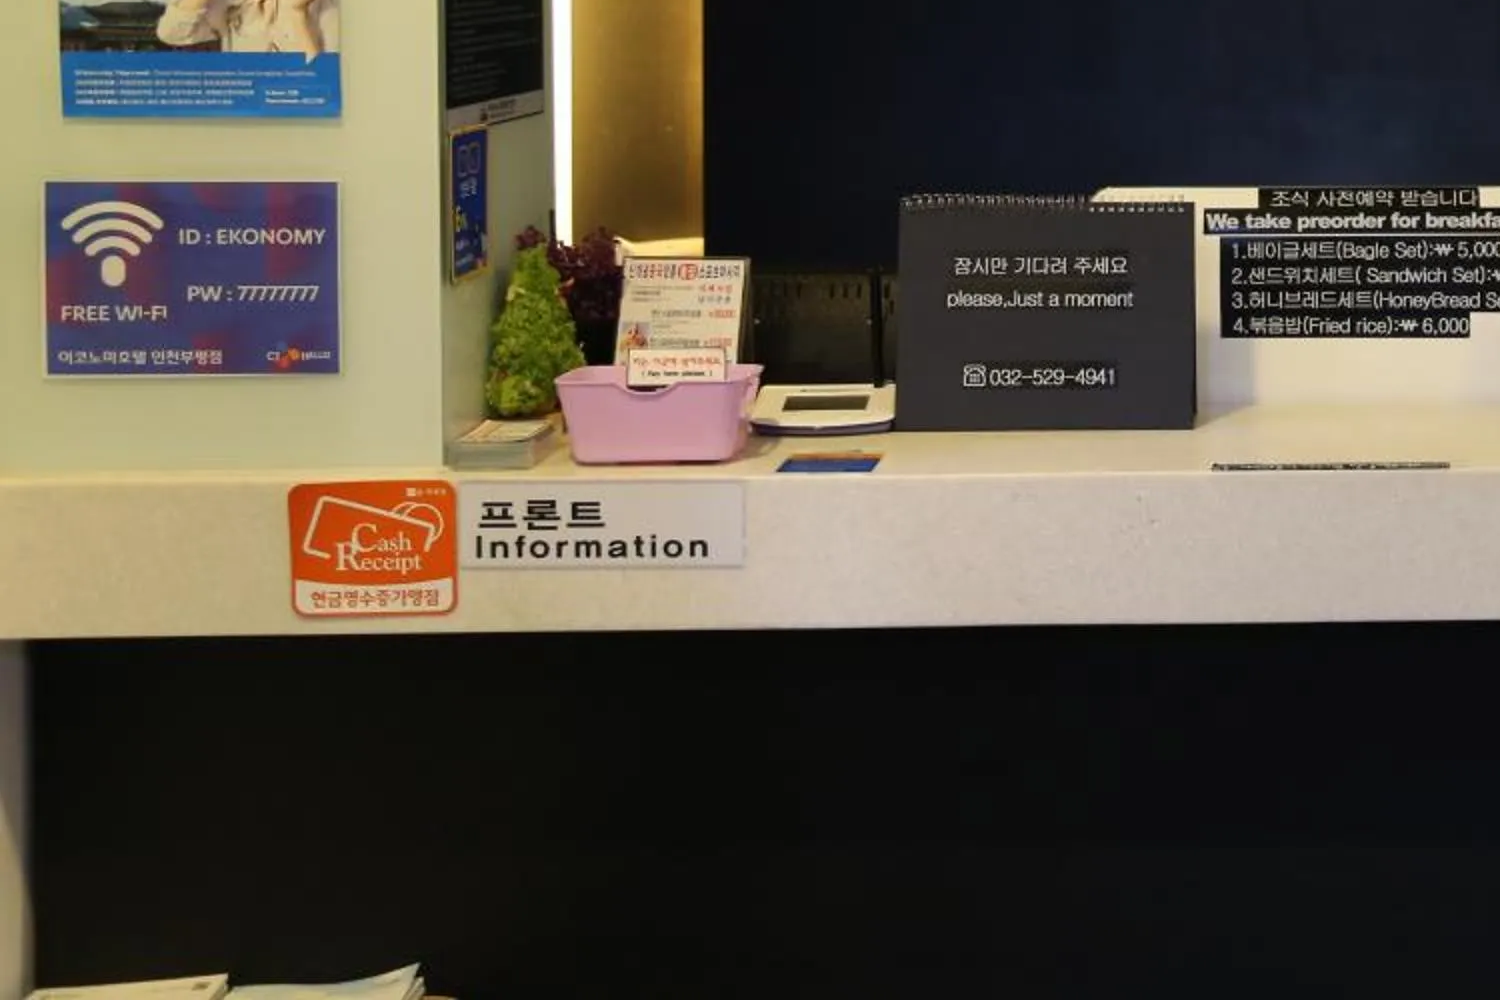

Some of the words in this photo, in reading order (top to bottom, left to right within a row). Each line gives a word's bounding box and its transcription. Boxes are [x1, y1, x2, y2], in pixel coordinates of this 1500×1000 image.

[1270, 190, 1309, 208] 조식
[1316, 190, 1395, 208] 사전예약
[1401, 189, 1479, 207] 받습니다
[1206, 211, 1239, 231] We
[1245, 211, 1292, 229] take
[1297, 211, 1387, 232] preorder
[1391, 211, 1421, 229] for
[179, 228, 201, 245] ID
[216, 228, 326, 245] EKONOMY
[954, 256, 1008, 275] 잠시만
[1014, 256, 1068, 275] 기다려
[1073, 256, 1128, 275] 주세요
[1366, 266, 1447, 285] Sandwich
[187, 285, 222, 301] PW
[947, 290, 1044, 309] please,Just
[1049, 292, 1060, 308] a
[1065, 290, 1134, 308] moment
[61, 305, 111, 321] FREE
[1422, 317, 1470, 335] 6,000
[989, 368, 1117, 386] 032-529-4941
[478, 499, 606, 532] 프론트
[351, 523, 413, 553] Cash
[475, 535, 710, 561] Information
[335, 542, 422, 575] Receipt
